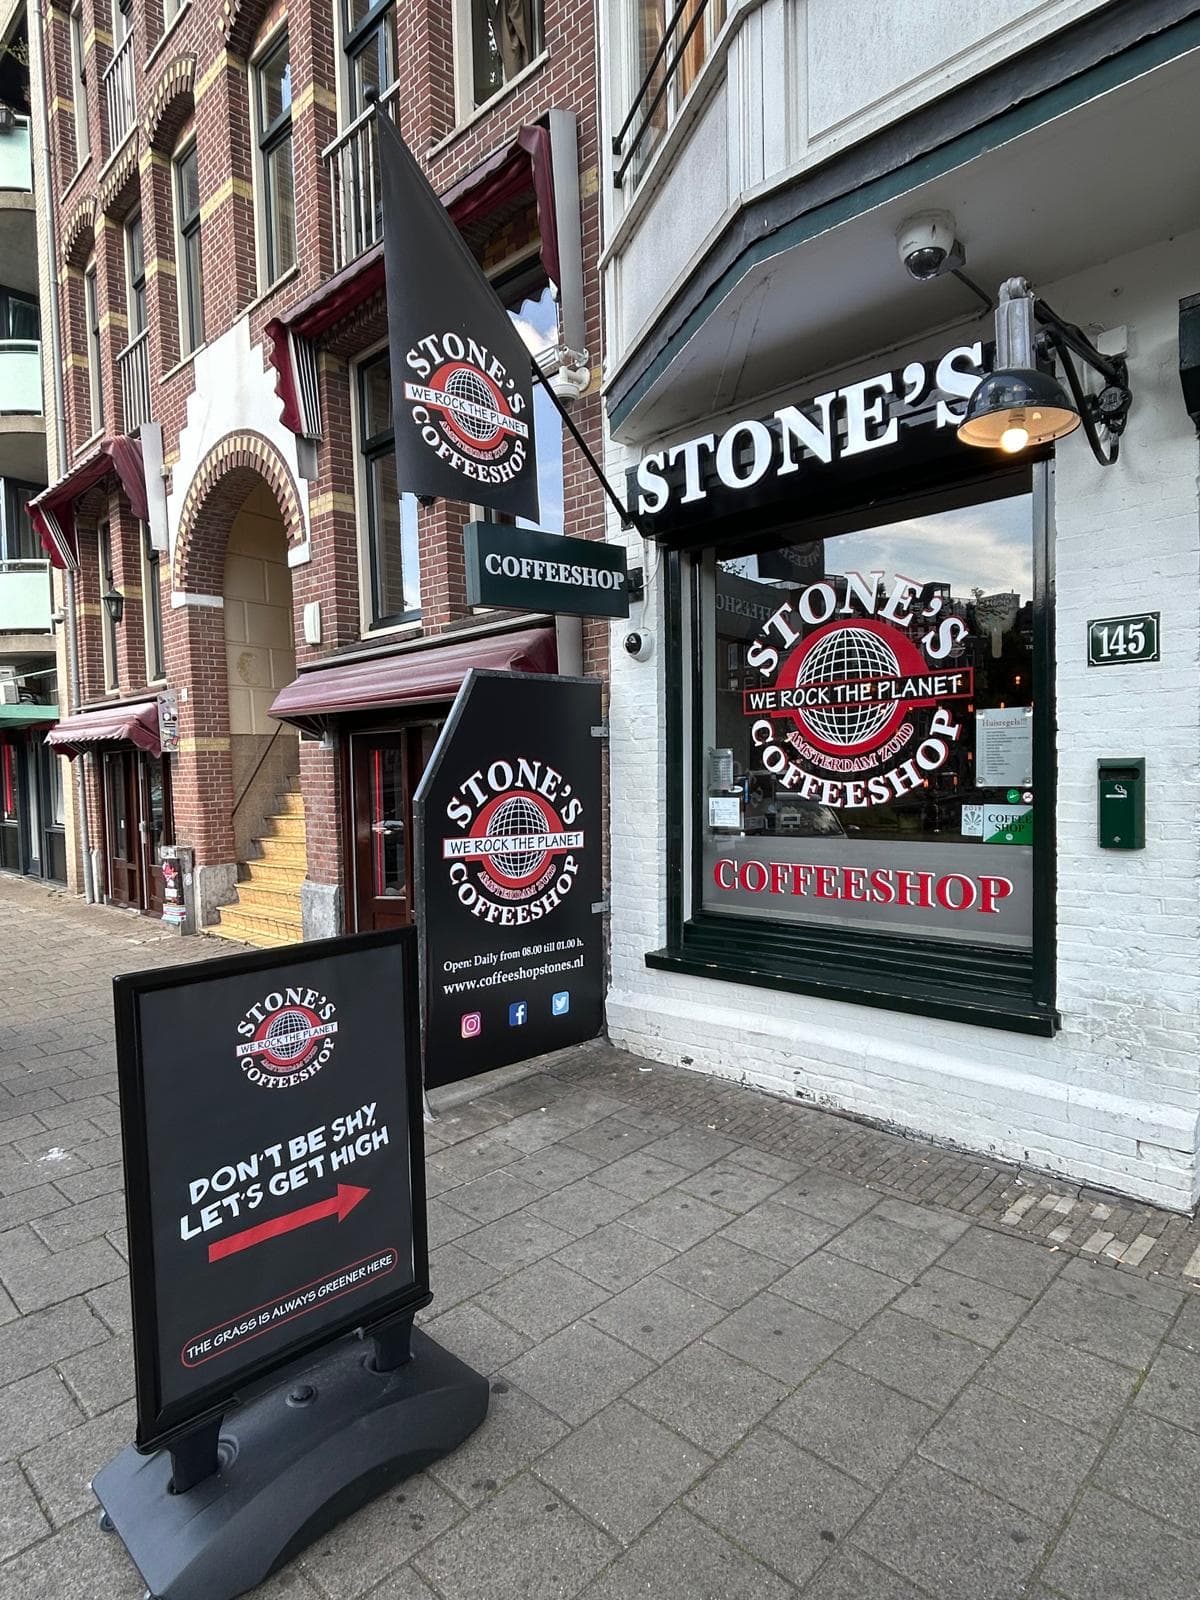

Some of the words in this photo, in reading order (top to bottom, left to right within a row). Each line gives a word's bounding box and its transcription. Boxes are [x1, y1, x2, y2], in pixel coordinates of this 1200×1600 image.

[406, 332, 526, 414] STONE'S
[411, 386, 435, 401] WE
[435, 393, 466, 411] ROCK
[469, 402, 488, 420] THE
[490, 413, 526, 434] PLANET
[636, 341, 983, 515] STONE'S
[412, 405, 527, 484] COFFEESHOP
[485, 553, 625, 590] COFFEESHOP
[747, 571, 968, 678] STONE'S
[1099, 622, 1146, 658] 145
[750, 691, 777, 710] WE
[780, 687, 831, 708] ROCK
[834, 684, 872, 702] THE
[878, 674, 962, 699] PLANET
[751, 708, 963, 809] COFFEESHOP
[787, 730, 879, 773] AMSTERDAM
[878, 722, 914, 762] ZUID
[446, 757, 584, 829] STONE'S
[450, 840, 471, 854] WE
[474, 839, 509, 853] ROCK
[511, 836, 535, 850] THE
[538, 833, 581, 849] PLANET
[988, 814, 1032, 824] COFFEE
[995, 823, 1025, 833] SHOP
[450, 855, 580, 926] COFFEESHOP
[713, 858, 1014, 913] COFFEESHOP
[443, 960, 473, 973] Open:
[474, 952, 499, 967] Daily
[499, 950, 521, 962] from
[522, 944, 543, 957] 08.00
[543, 941, 556, 953] till
[556, 938, 576, 951] 01.00
[576, 937, 585, 947] h.
[443, 954, 585, 995] www.coffeeshopstones.nl
[237, 987, 336, 1038] STONE'S
[240, 1045, 255, 1054] WE
[257, 1038, 282, 1049] ROCK
[285, 1032, 301, 1041] THE
[303, 1024, 335, 1039] PLANET
[240, 1037, 335, 1089] COFFEESHOP
[189, 1143, 283, 1205] DON'T
[288, 1125, 327, 1161] BE
[331, 1101, 377, 1142] SHY,
[180, 1183, 264, 1241] LET'S
[268, 1155, 325, 1196] GET
[330, 1125, 390, 1172] HIGH
[187, 1339, 212, 1359] THE
[213, 1318, 257, 1347] GRASS
[258, 1311, 271, 1326] IS
[271, 1290, 317, 1320] ALWAYS
[317, 1266, 367, 1297] GREENER
[367, 1254, 393, 1276] HERE
